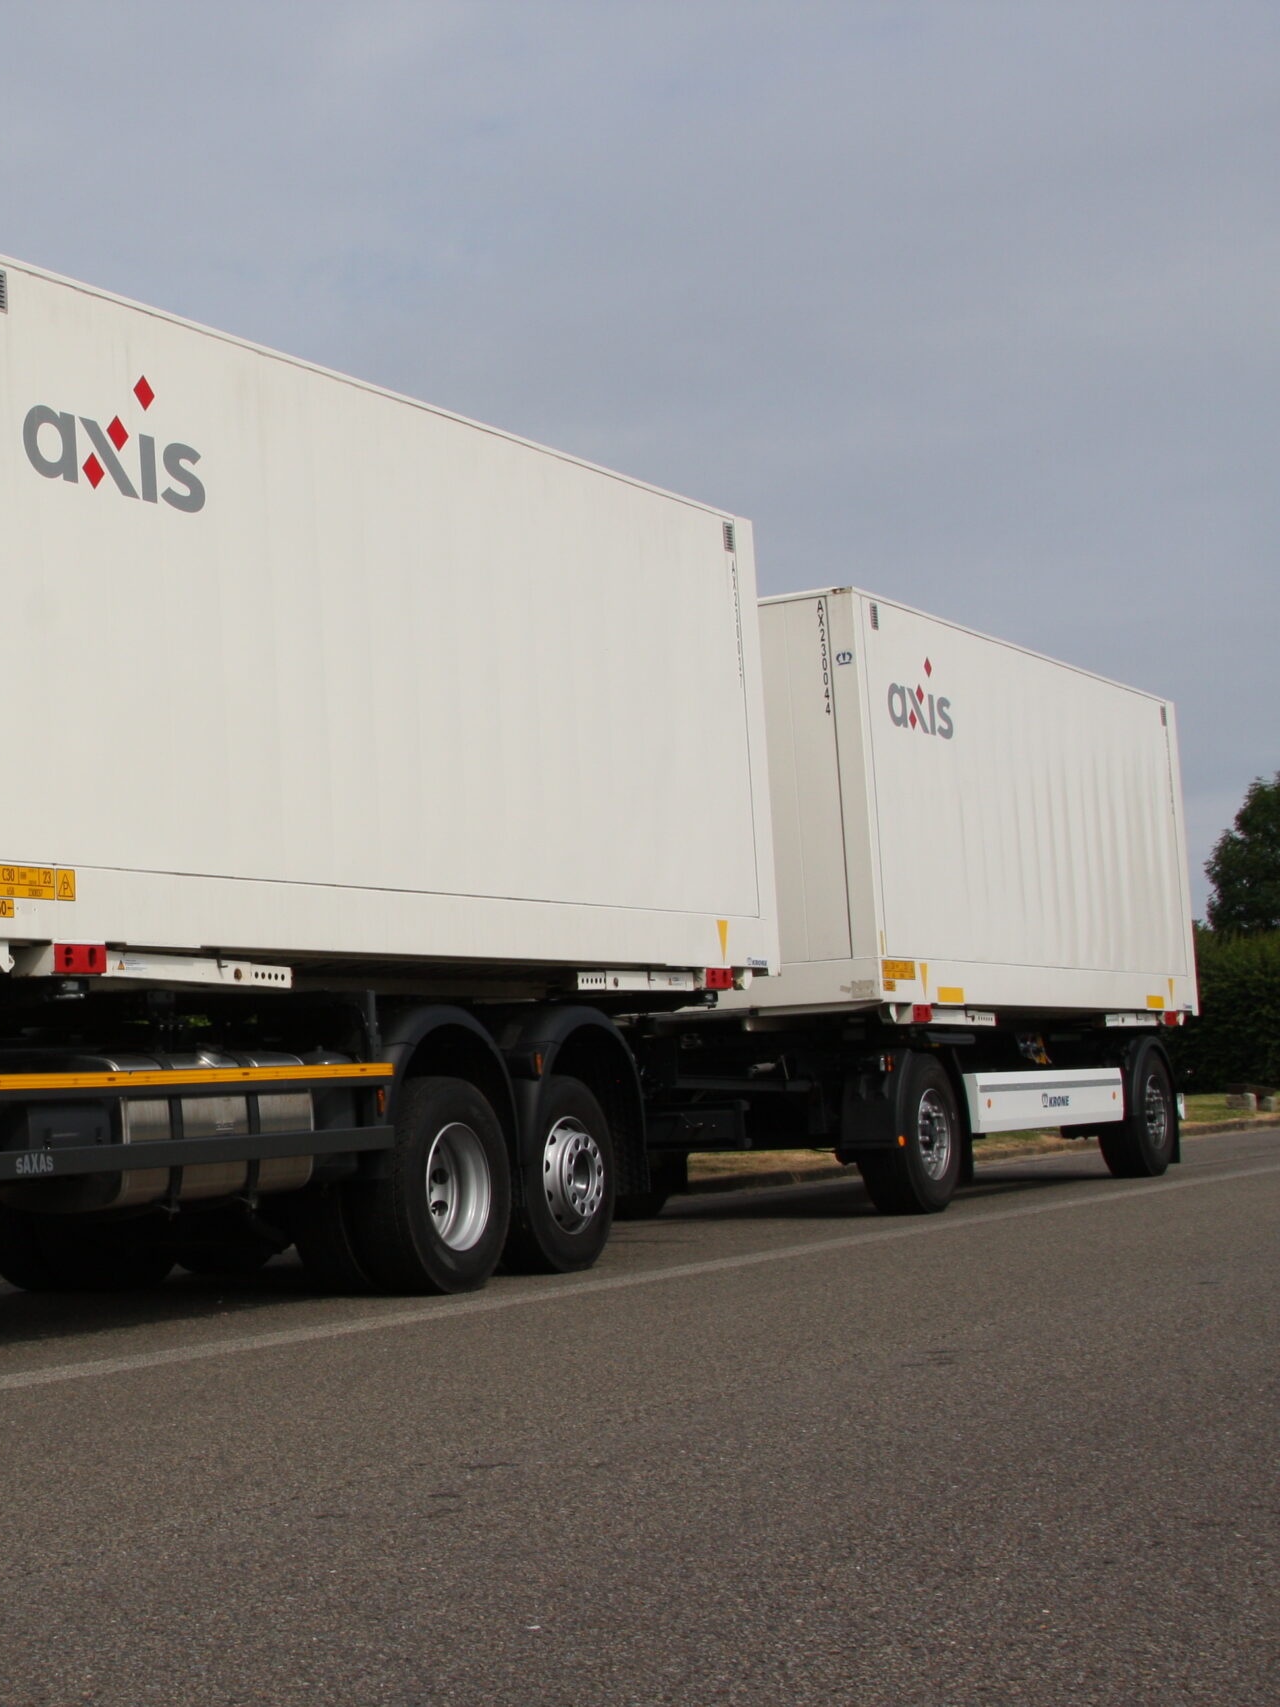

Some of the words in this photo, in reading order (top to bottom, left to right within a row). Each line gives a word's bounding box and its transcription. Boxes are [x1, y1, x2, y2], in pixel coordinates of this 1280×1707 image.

[23, 375, 206, 513] axis
[817, 600, 831, 715] AX230044
[888, 656, 953, 739] axis
[2, 868, 15, 882] C30
[1049, 1095, 1070, 1107] KRONE
[15, 1153, 54, 1174] SAXAS
